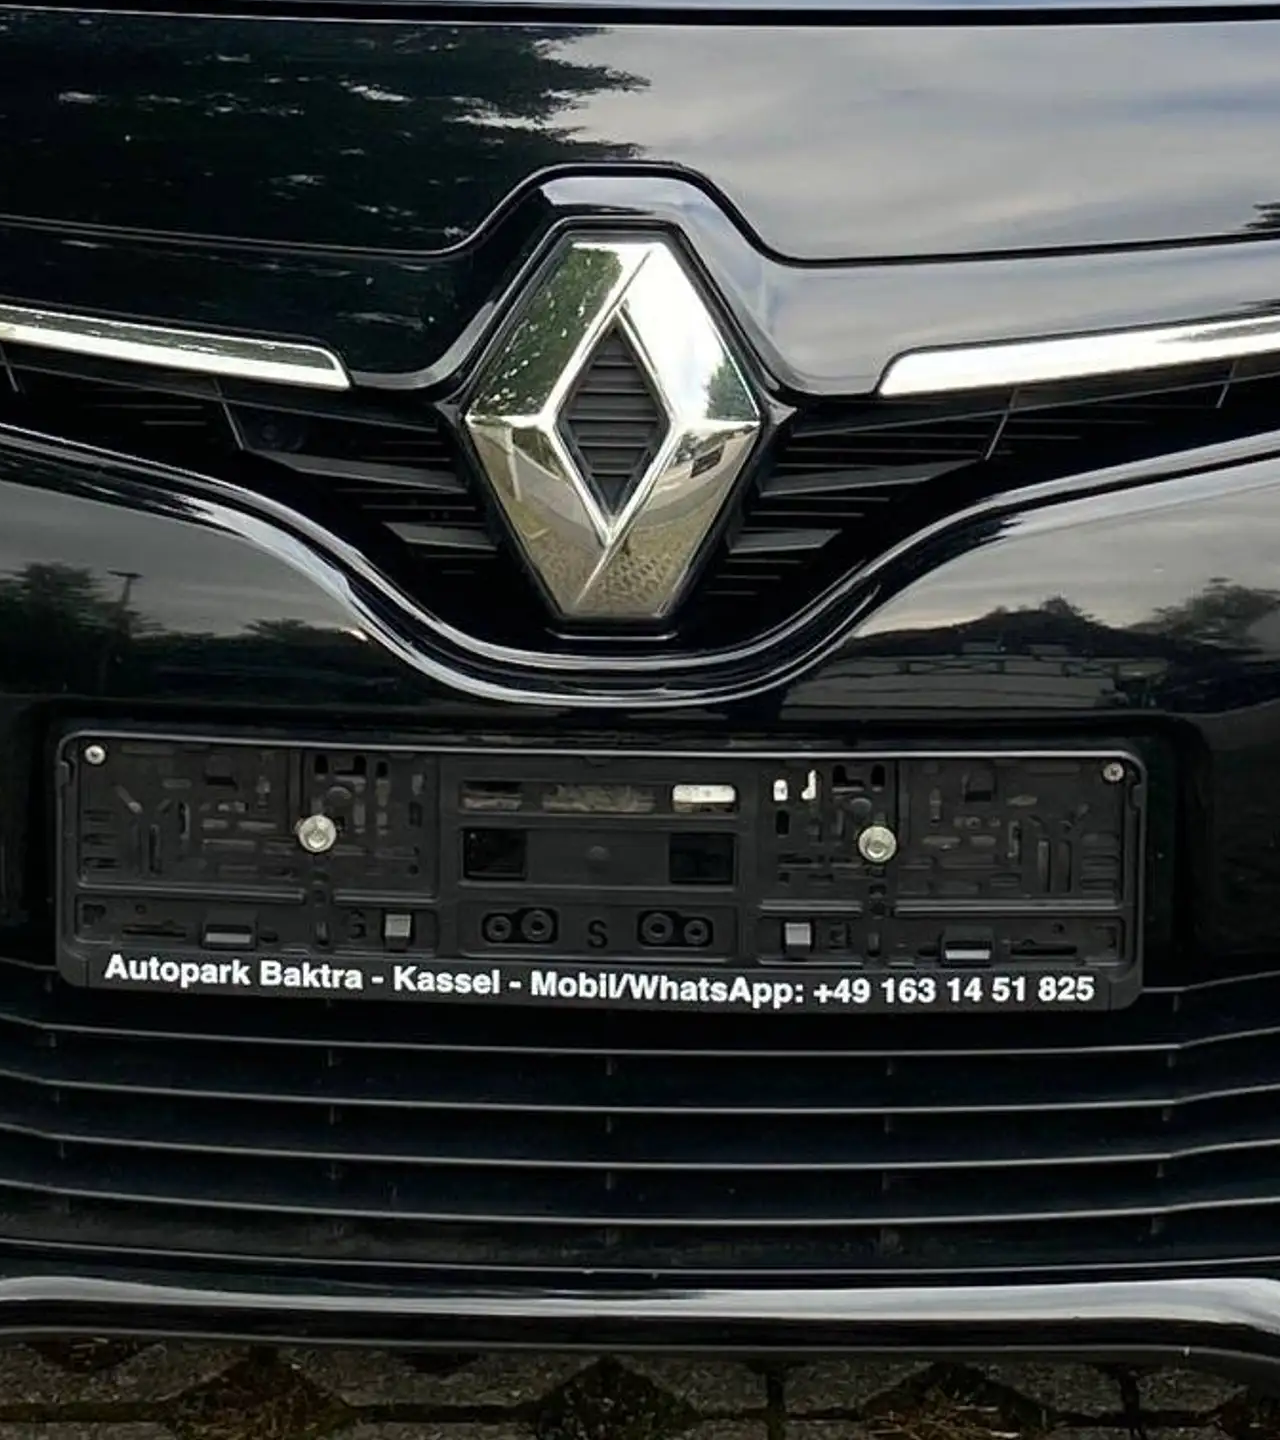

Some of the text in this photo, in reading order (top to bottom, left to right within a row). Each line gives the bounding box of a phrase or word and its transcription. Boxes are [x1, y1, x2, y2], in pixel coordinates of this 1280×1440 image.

[104, 953, 252, 989] Autopark
[259, 959, 364, 990] Baktra
[393, 965, 501, 995] Kassel
[530, 970, 804, 1010] Mobil/WhatsApp:
[813, 977, 871, 1004] +49
[880, 977, 937, 1004] 163
[946, 977, 984, 1003] 14
[991, 976, 1026, 1002] 51
[1037, 975, 1095, 1002] 825
